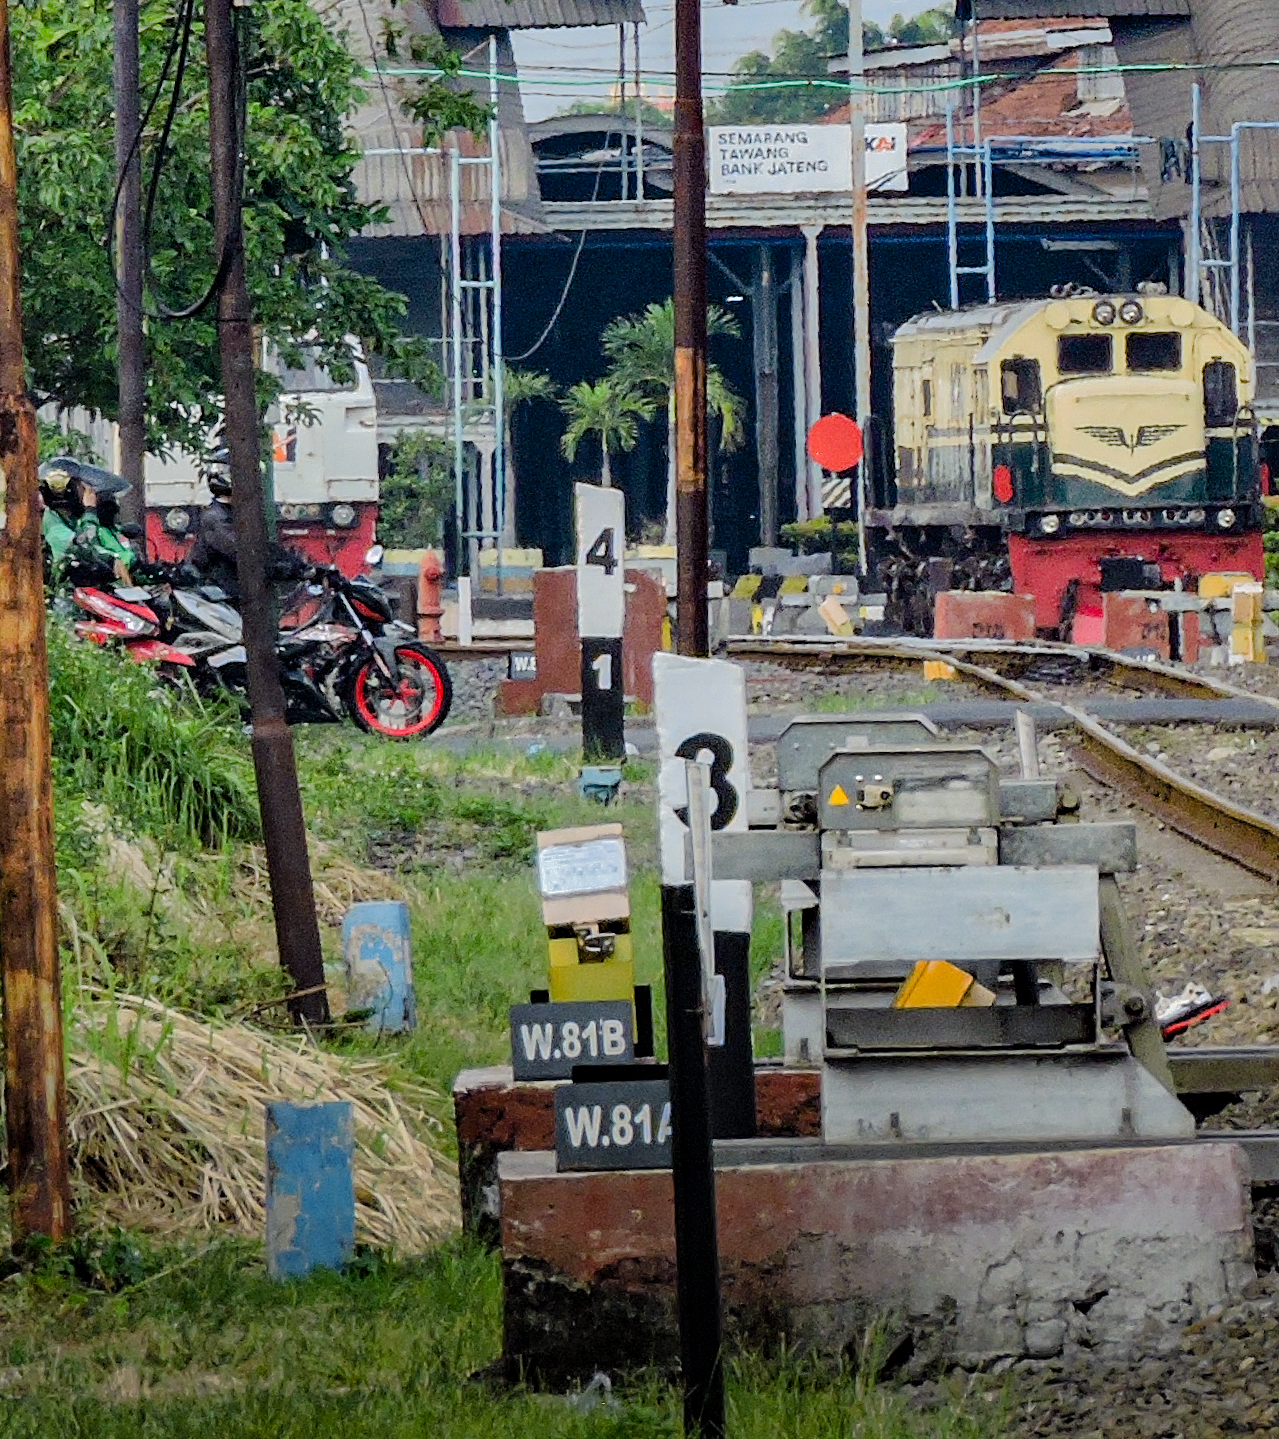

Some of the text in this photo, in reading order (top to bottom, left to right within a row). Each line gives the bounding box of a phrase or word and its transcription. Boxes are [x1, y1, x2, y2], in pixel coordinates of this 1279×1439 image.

[718, 131, 809, 145] SEMARANG
[719, 147, 790, 160] TAWANG
[721, 160, 829, 176] BANK JATENG
[586, 526, 619, 576] 4
[592, 653, 612, 690] 1
[673, 732, 740, 831] 3
[520, 1019, 626, 1061] W.81B
